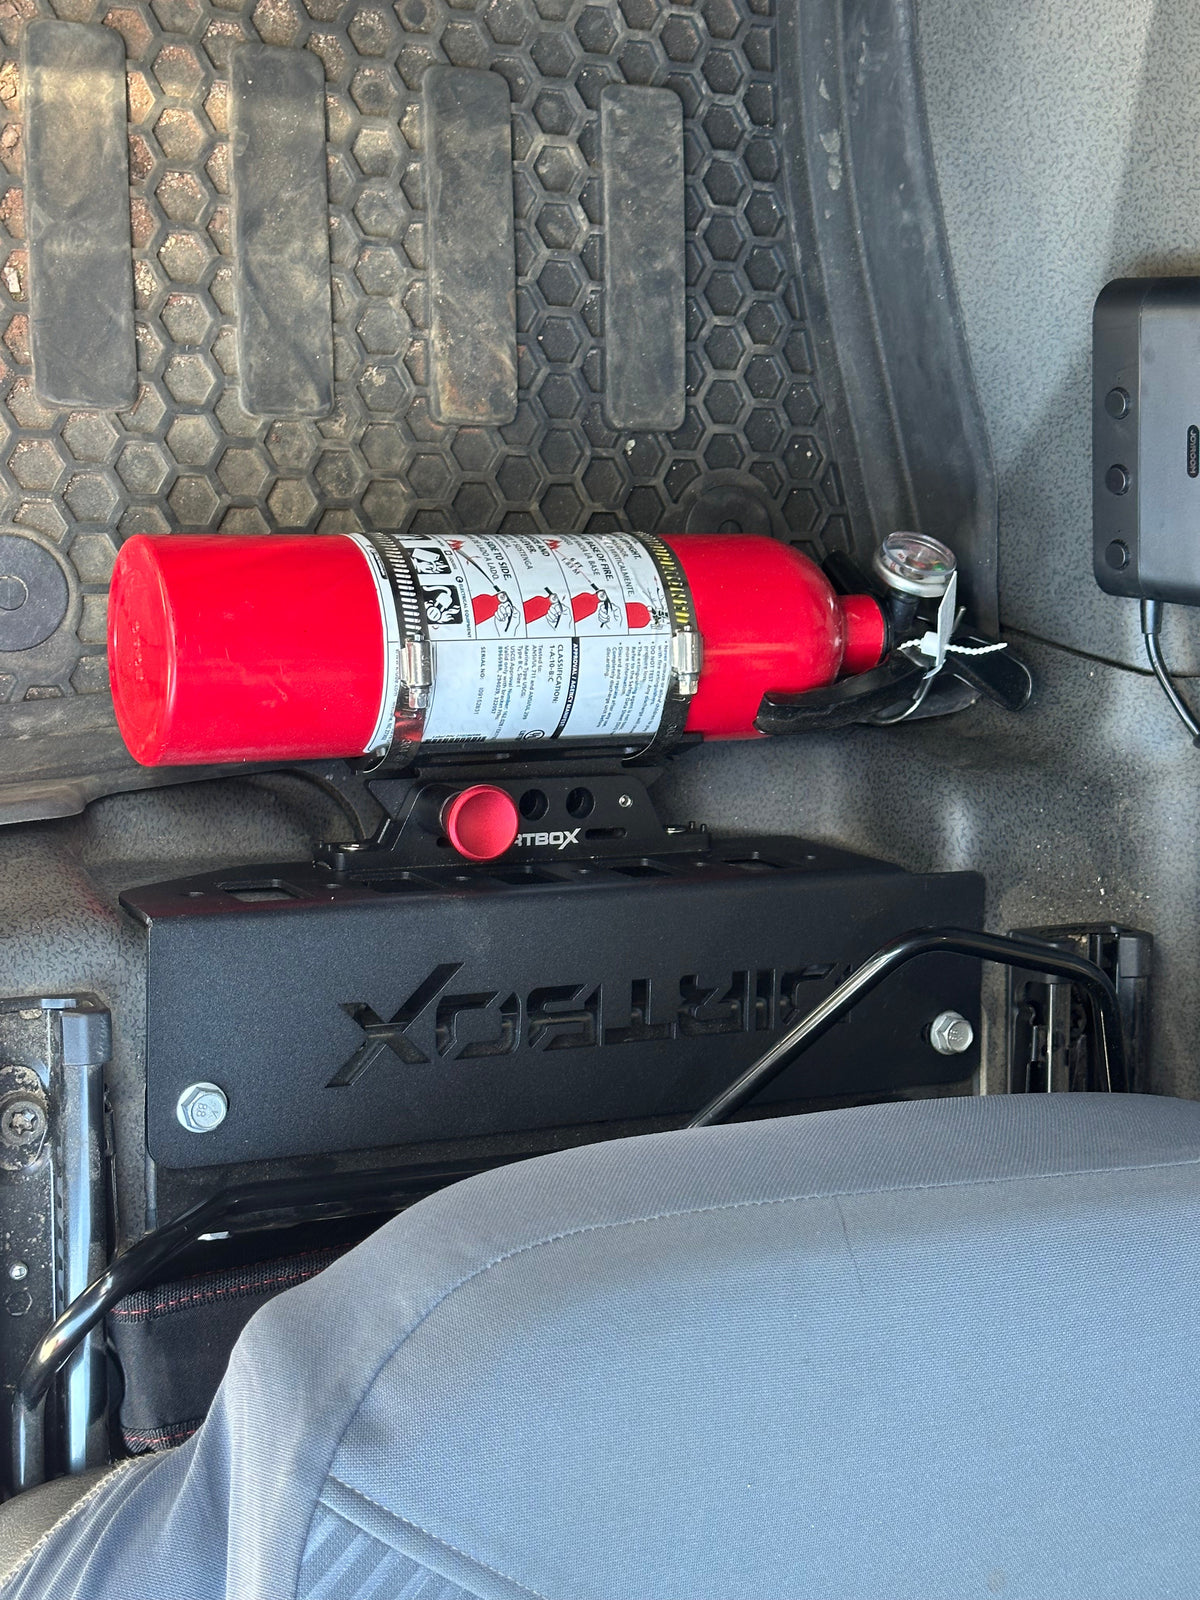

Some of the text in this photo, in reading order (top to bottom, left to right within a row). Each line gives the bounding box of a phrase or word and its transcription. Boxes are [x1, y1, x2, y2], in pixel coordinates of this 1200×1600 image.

[484, 541, 499, 552] SIDE
[494, 552, 504, 560] TO
[586, 541, 601, 553] BASE
[596, 554, 606, 563] OF
[601, 564, 614, 581] FIRE.
[588, 560, 600, 575] BASE
[487, 562, 499, 581] LADO.
[498, 562, 512, 580] SIDE.
[459, 584, 468, 608] ELECTRICAL
[464, 610, 472, 638] EQUIPMENT
[650, 645, 656, 654] DO
[552, 644, 564, 704] CLASSIFICATION:
[567, 680, 576, 703] AGENCY
[514, 828, 581, 850] RTBOX
